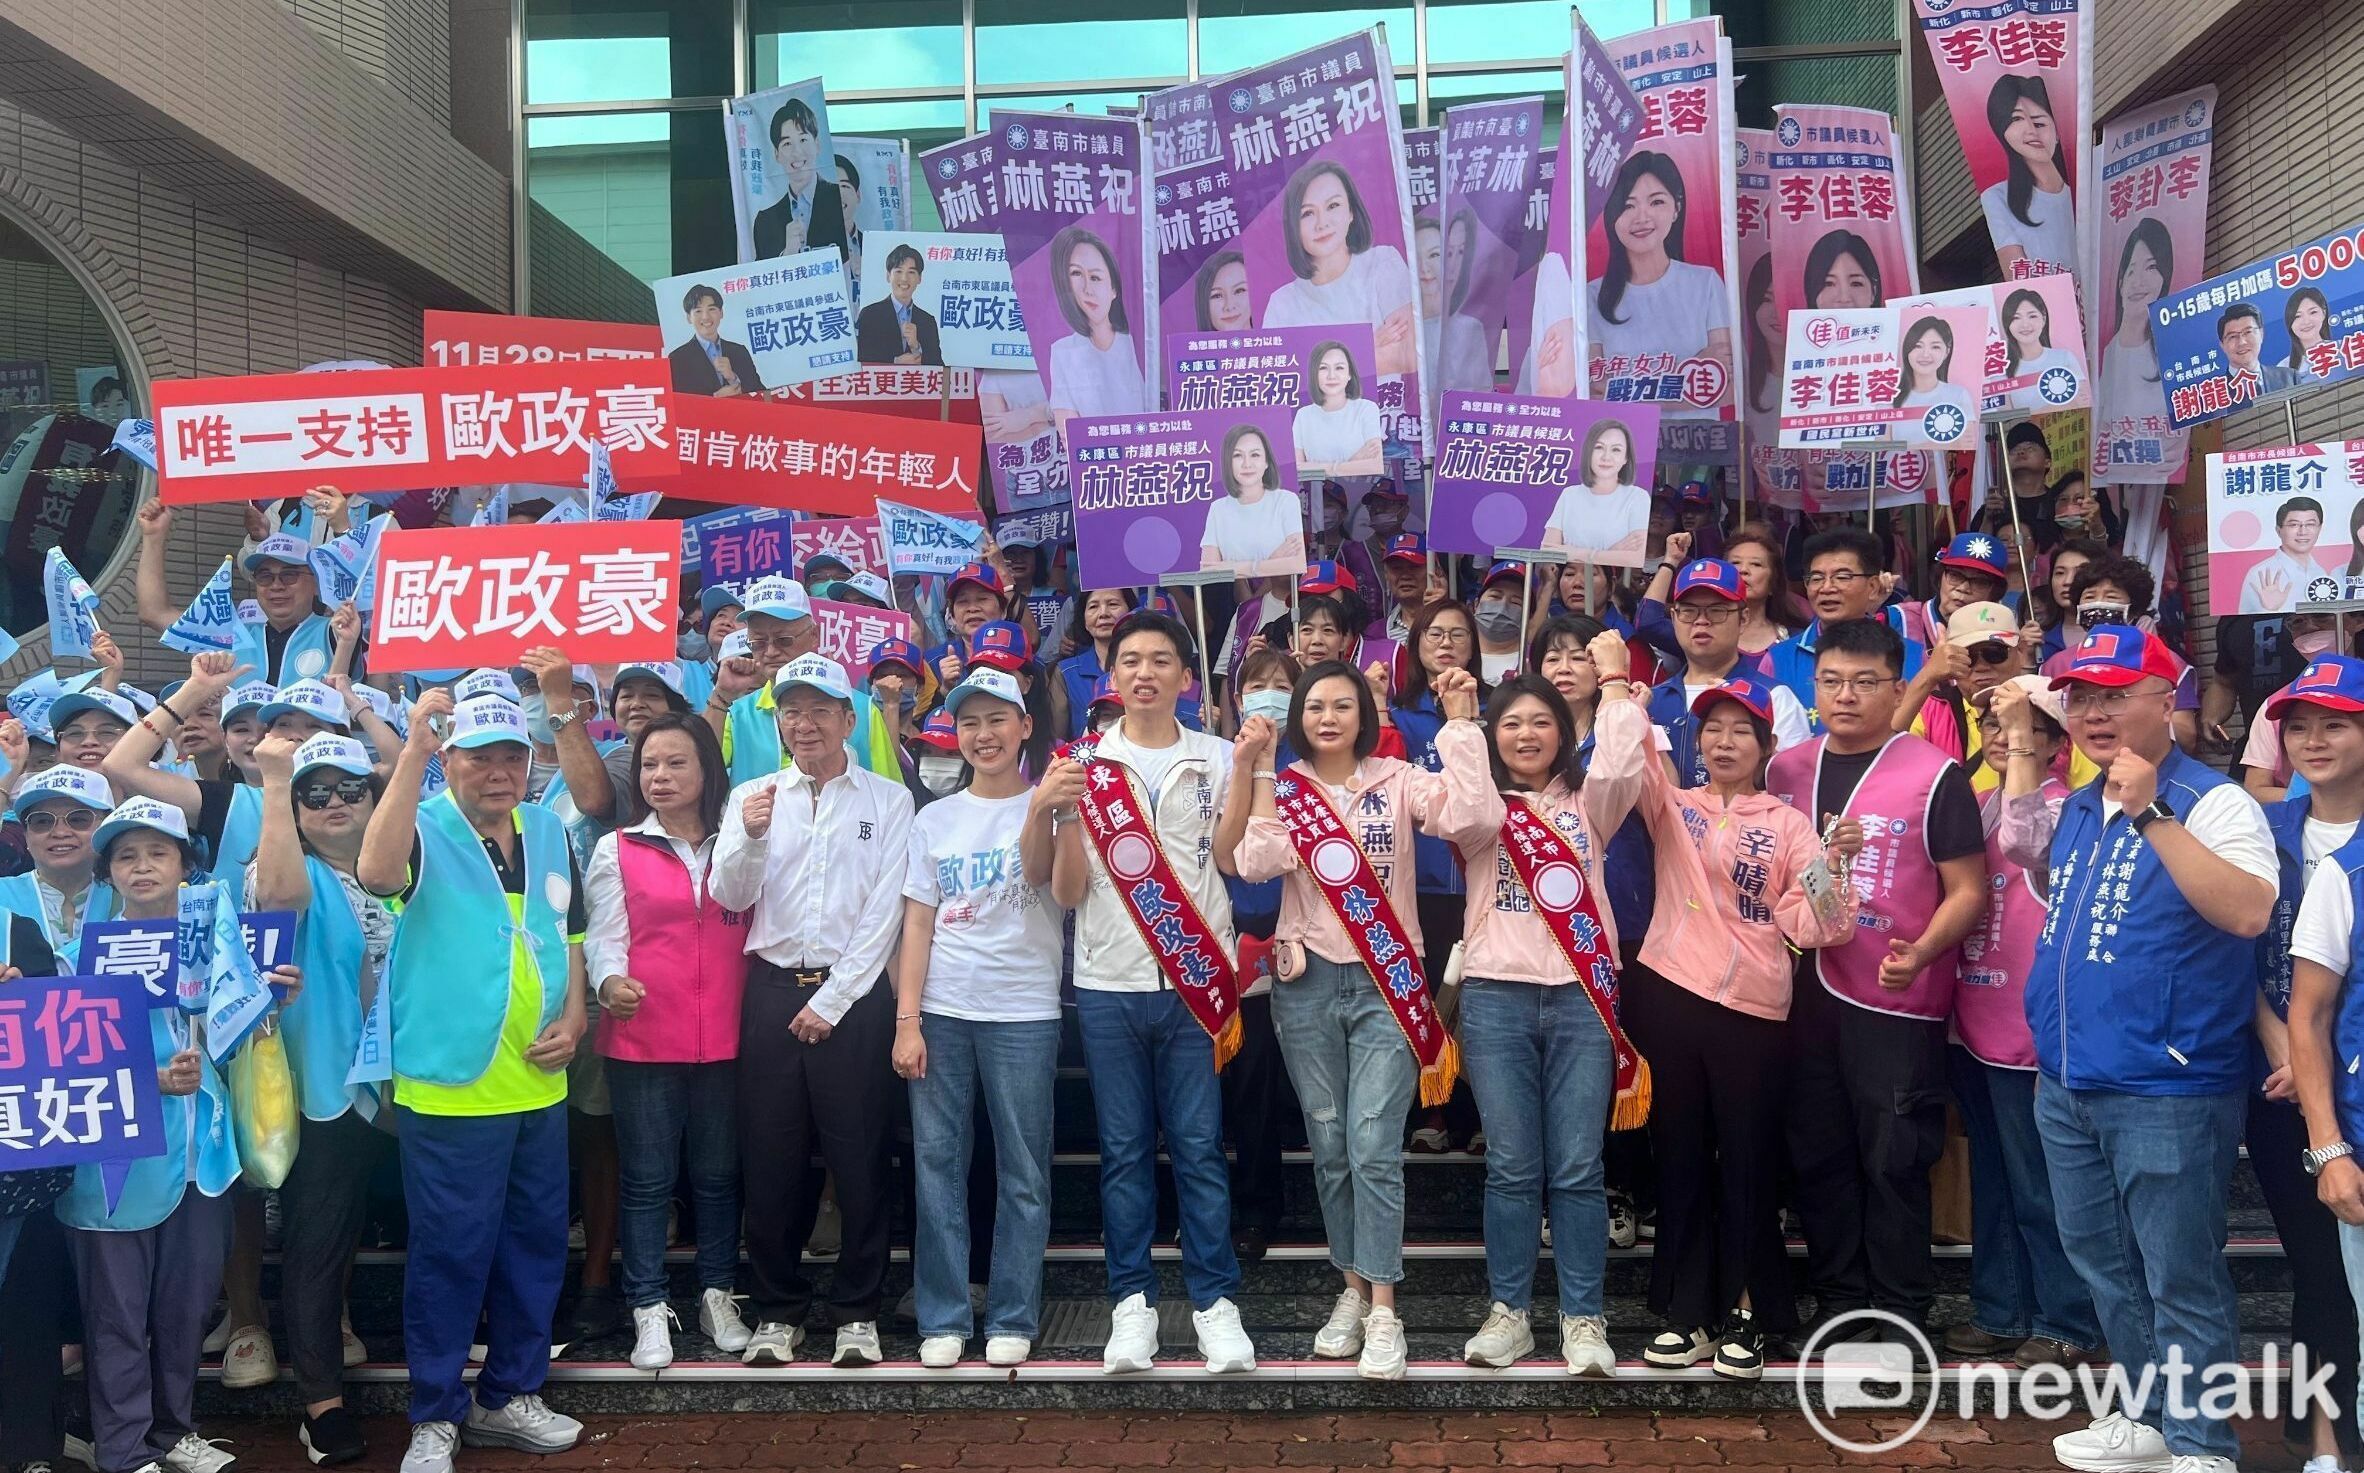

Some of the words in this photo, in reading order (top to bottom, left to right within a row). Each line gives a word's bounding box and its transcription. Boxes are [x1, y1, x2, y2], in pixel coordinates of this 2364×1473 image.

[1939, 20, 2067, 72] 李佳蓉
[1255, 51, 1363, 105] 臺南市議員
[1033, 128, 1124, 156] 臺南市議員
[1229, 78, 1382, 172] 林燕祝
[1806, 126, 1885, 147] 市議員候選人
[1002, 158, 1136, 215] 林燕祝
[1779, 174, 1895, 222] 李佳蓉
[942, 279, 1015, 292] 台南市東區議員
[747, 305, 851, 355] 歐政豪
[1179, 359, 1218, 373] 永康區
[1220, 354, 1300, 371] 市議員候選人
[1792, 353, 1896, 370] 臺南市市議員候選人
[2175, 363, 2220, 383] 市長候選人
[1177, 371, 1300, 411] 林燕祝
[1519, 404, 1562, 418] 全力以赴
[1790, 369, 1901, 409] 李佳蓉
[2171, 368, 2258, 422] 謝龍介
[177, 404, 412, 468] 唯一支持
[441, 384, 671, 461] 歐政豪
[1447, 421, 1488, 436] 永康區
[1491, 423, 1575, 442] 市議員候選人
[1079, 447, 1121, 462] 永康區
[1124, 439, 1212, 460] 市議員候選人
[1439, 437, 1573, 486] 林燕祝
[2228, 446, 2306, 462] 台南市市長候選人
[1079, 460, 1213, 511] 林燕祝
[2225, 459, 2328, 496] 謝龍介
[709, 527, 781, 577] 有你
[379, 548, 668, 646] 歐政豪
[474, 710, 518, 726] 歐政豪
[1090, 764, 1135, 831] 東區
[1510, 810, 1560, 857] 台南市
[1130, 877, 1220, 988] 歐政豪
[1342, 884, 1423, 1000] 林燕祝
